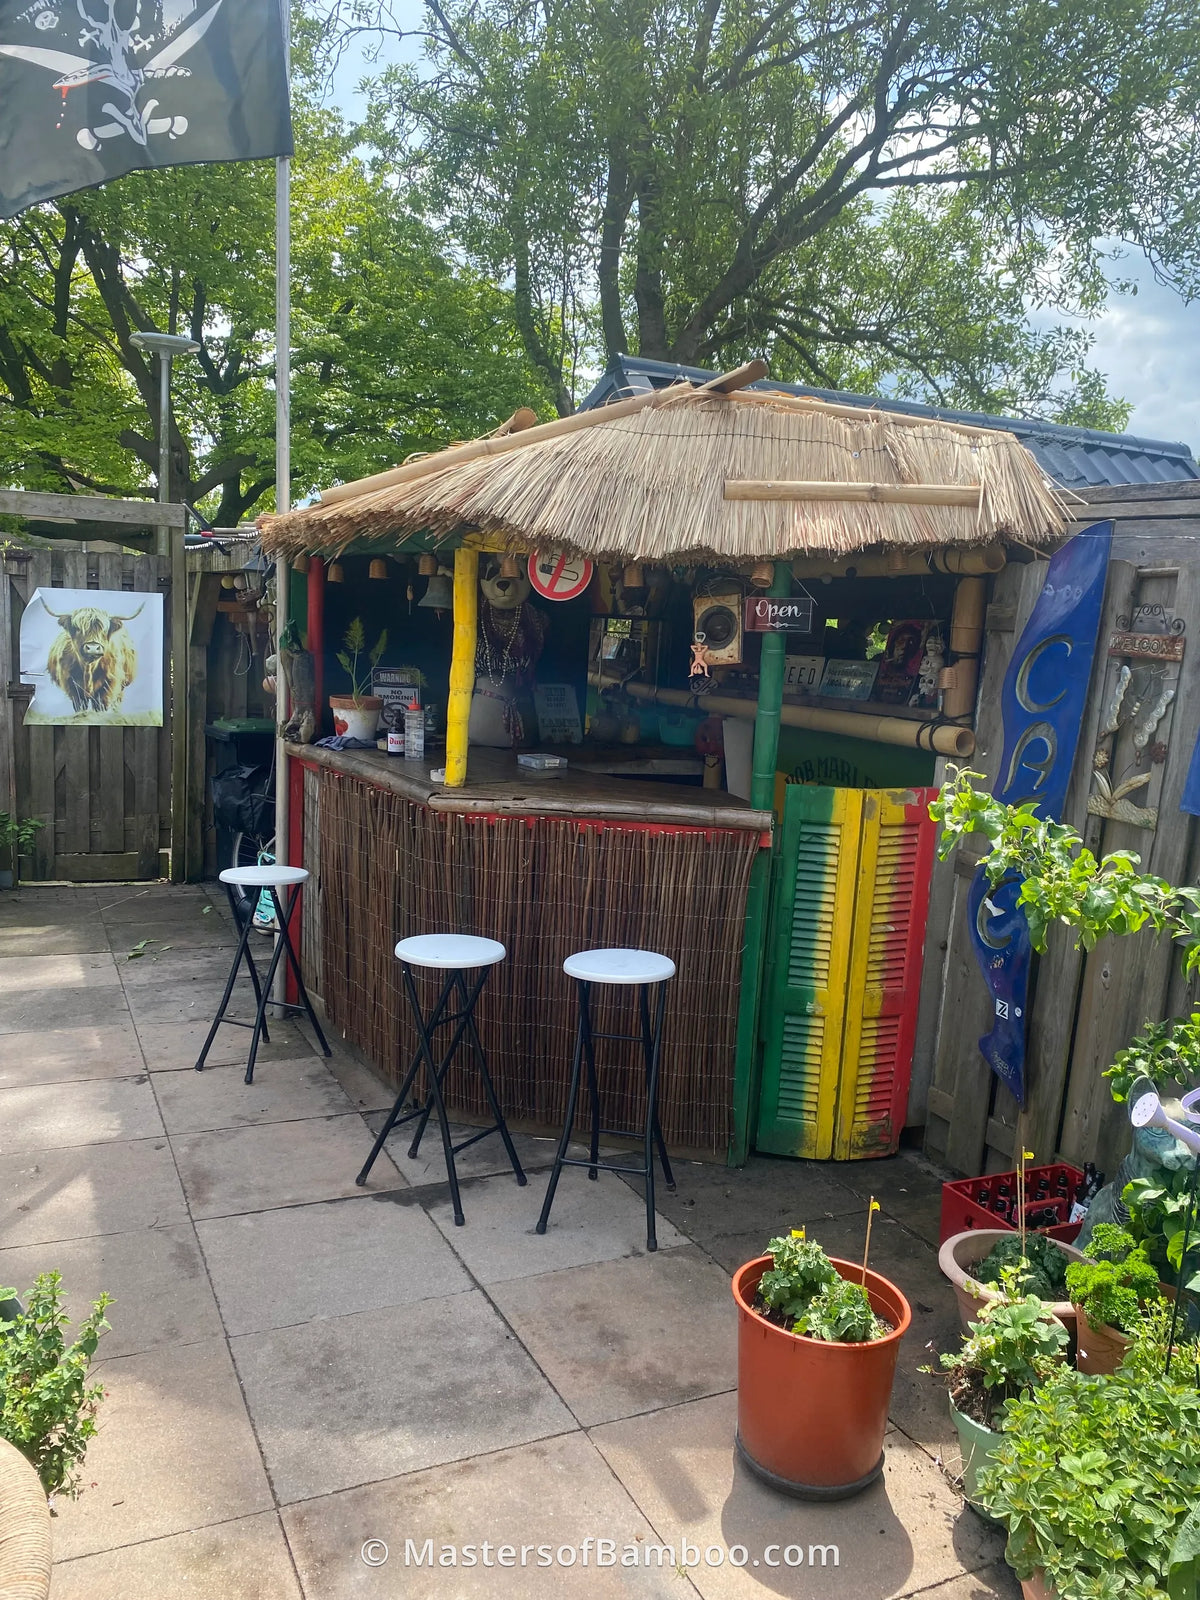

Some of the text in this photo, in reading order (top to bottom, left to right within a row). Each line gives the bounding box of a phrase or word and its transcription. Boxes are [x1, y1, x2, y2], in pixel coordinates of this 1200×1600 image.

[755, 599, 802, 623] Open
[1109, 636, 1183, 656] WELCOME
[784, 666, 816, 685] EED
